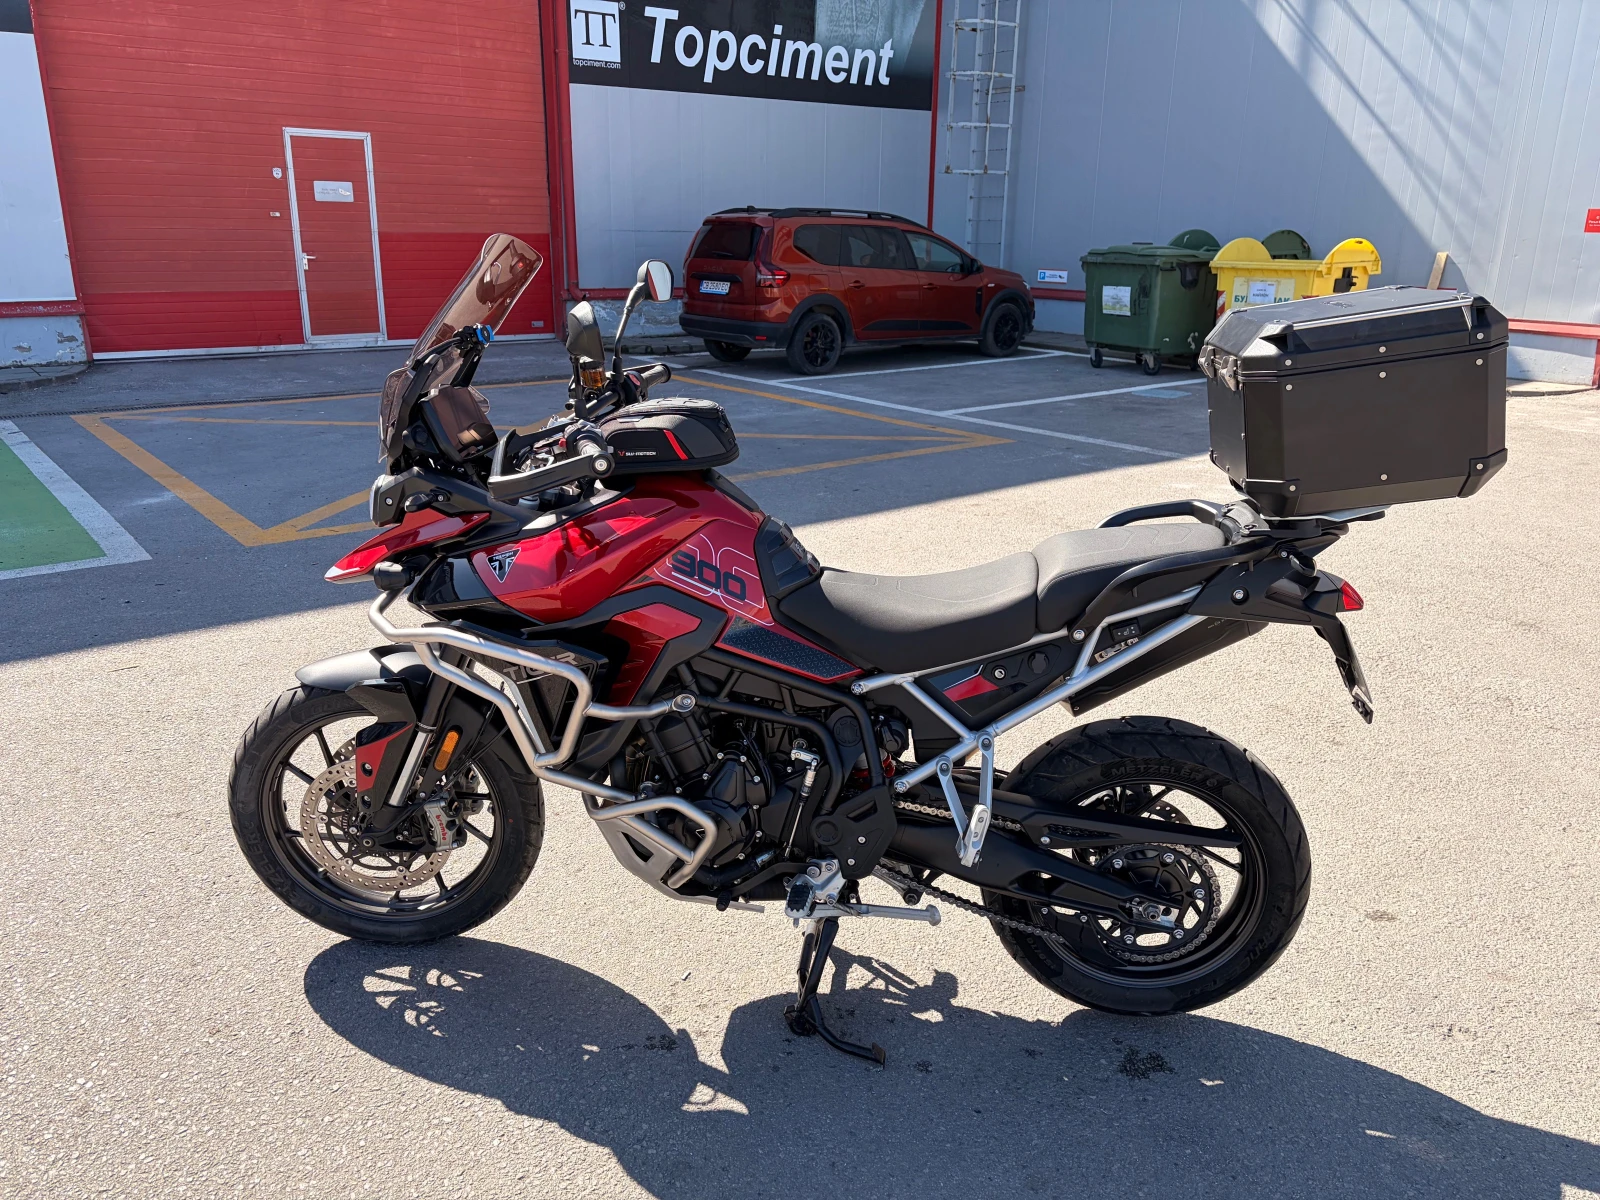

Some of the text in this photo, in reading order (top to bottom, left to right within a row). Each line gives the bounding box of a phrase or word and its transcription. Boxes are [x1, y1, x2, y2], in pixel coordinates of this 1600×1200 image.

[644, 6, 894, 87] Topciment
[573, 58, 621, 69] topciment.com
[671, 549, 747, 601] 900
[503, 652, 578, 681] TIGR
[1111, 764, 1206, 781] METZELER
[435, 814, 448, 841] brembo
